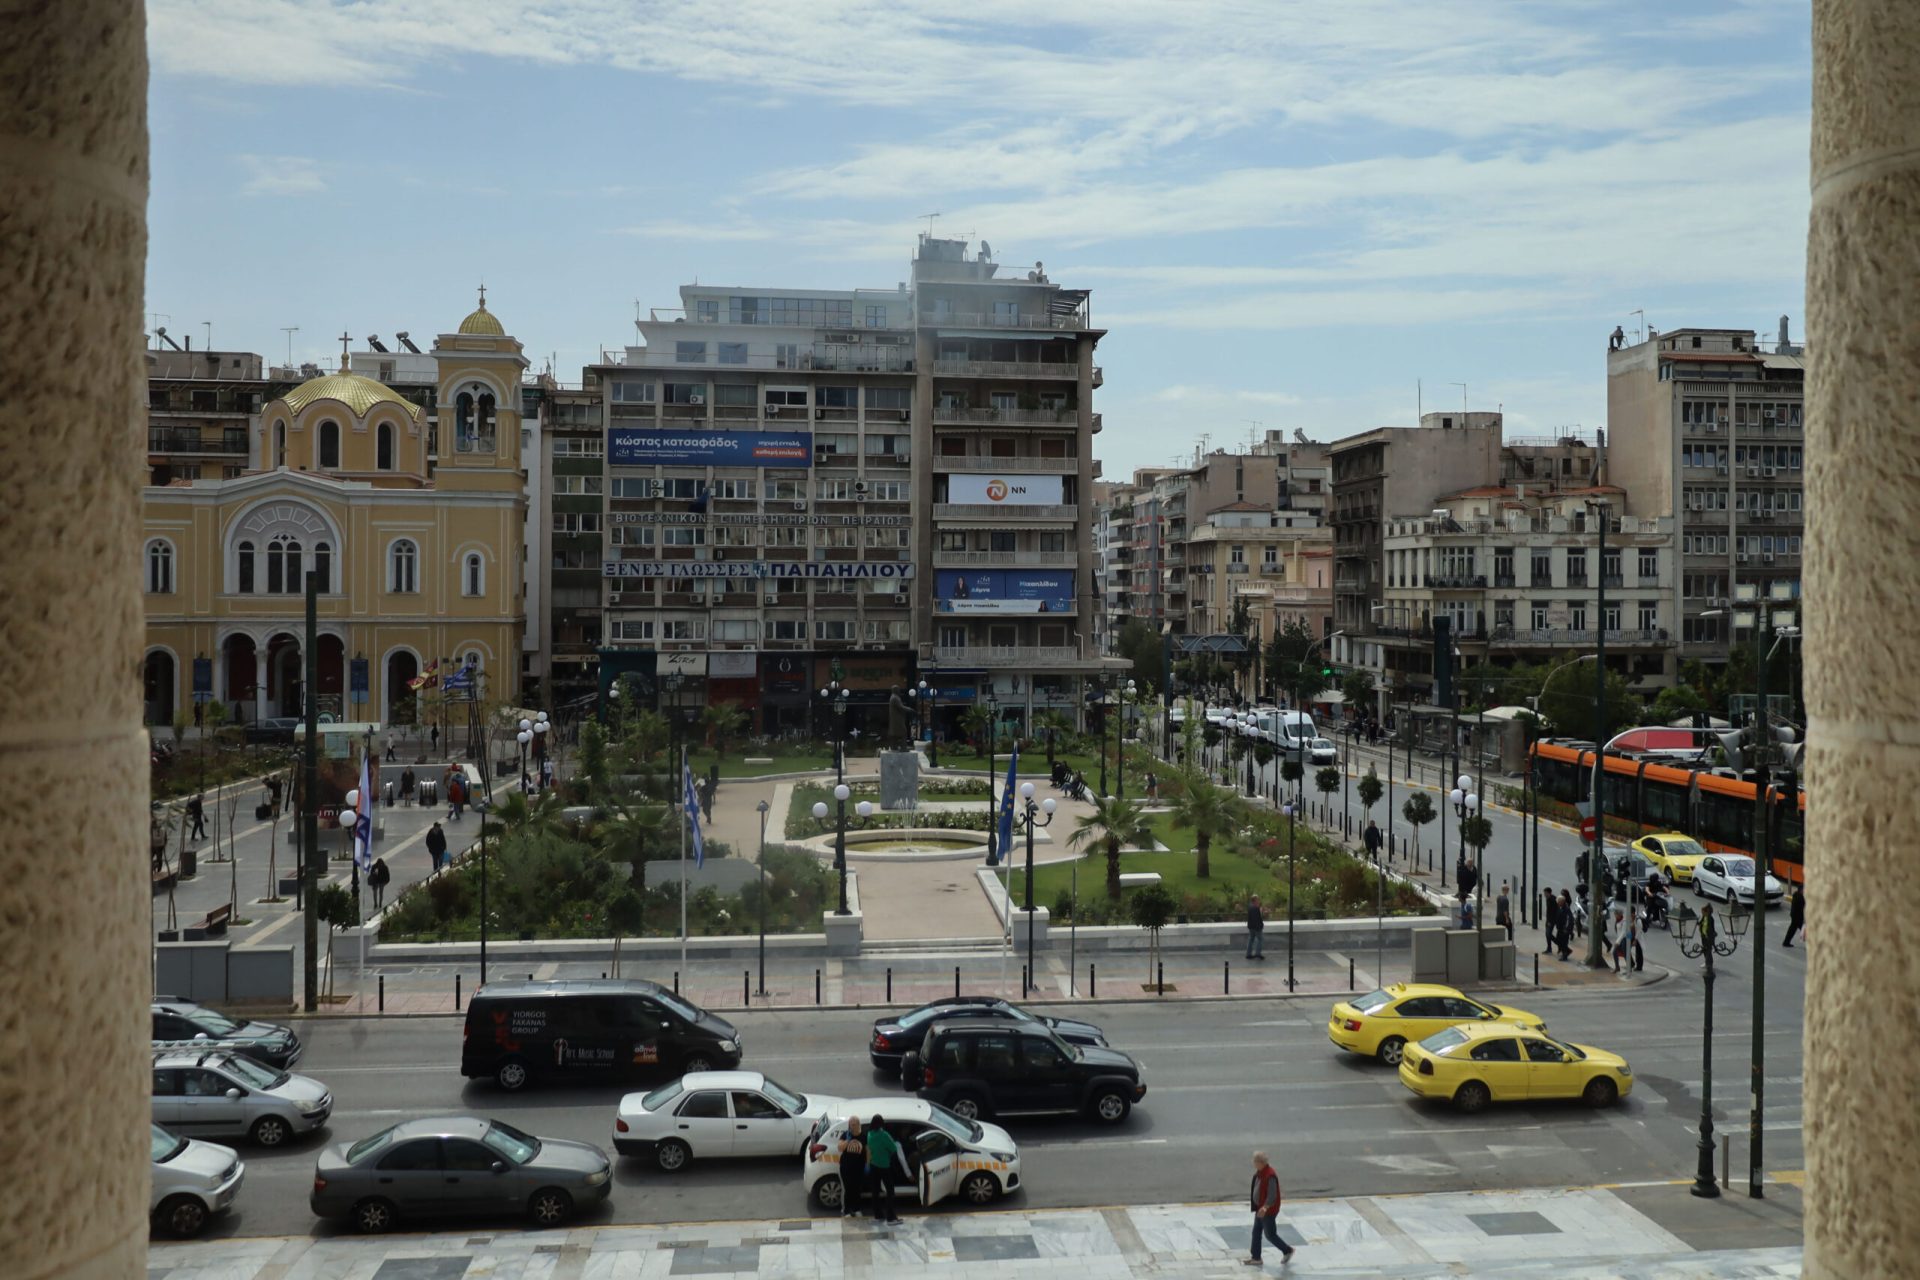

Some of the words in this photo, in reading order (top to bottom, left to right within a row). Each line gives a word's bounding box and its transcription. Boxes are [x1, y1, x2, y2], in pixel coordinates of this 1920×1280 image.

[616, 435, 661, 448] κώστας
[663, 437, 738, 449] κατσαφάδος
[1011, 486, 1026, 494] NN
[615, 513, 706, 523] ΒΙΟΤΕΧΝΙΚΟΝ
[720, 514, 828, 525] ΕΠΙΜΕΛΗΤΗΡΙΟΝ
[842, 516, 902, 525] ΠΕΙΡΑΙΩΣ
[605, 563, 664, 576] ΞΕΝΕΣ
[671, 563, 749, 576] ΓΛΩΣΣΕΣ
[771, 563, 910, 577] ΠΑΠΑΗΛΙΟΥ
[513, 1010, 546, 1018] YIORGOS
